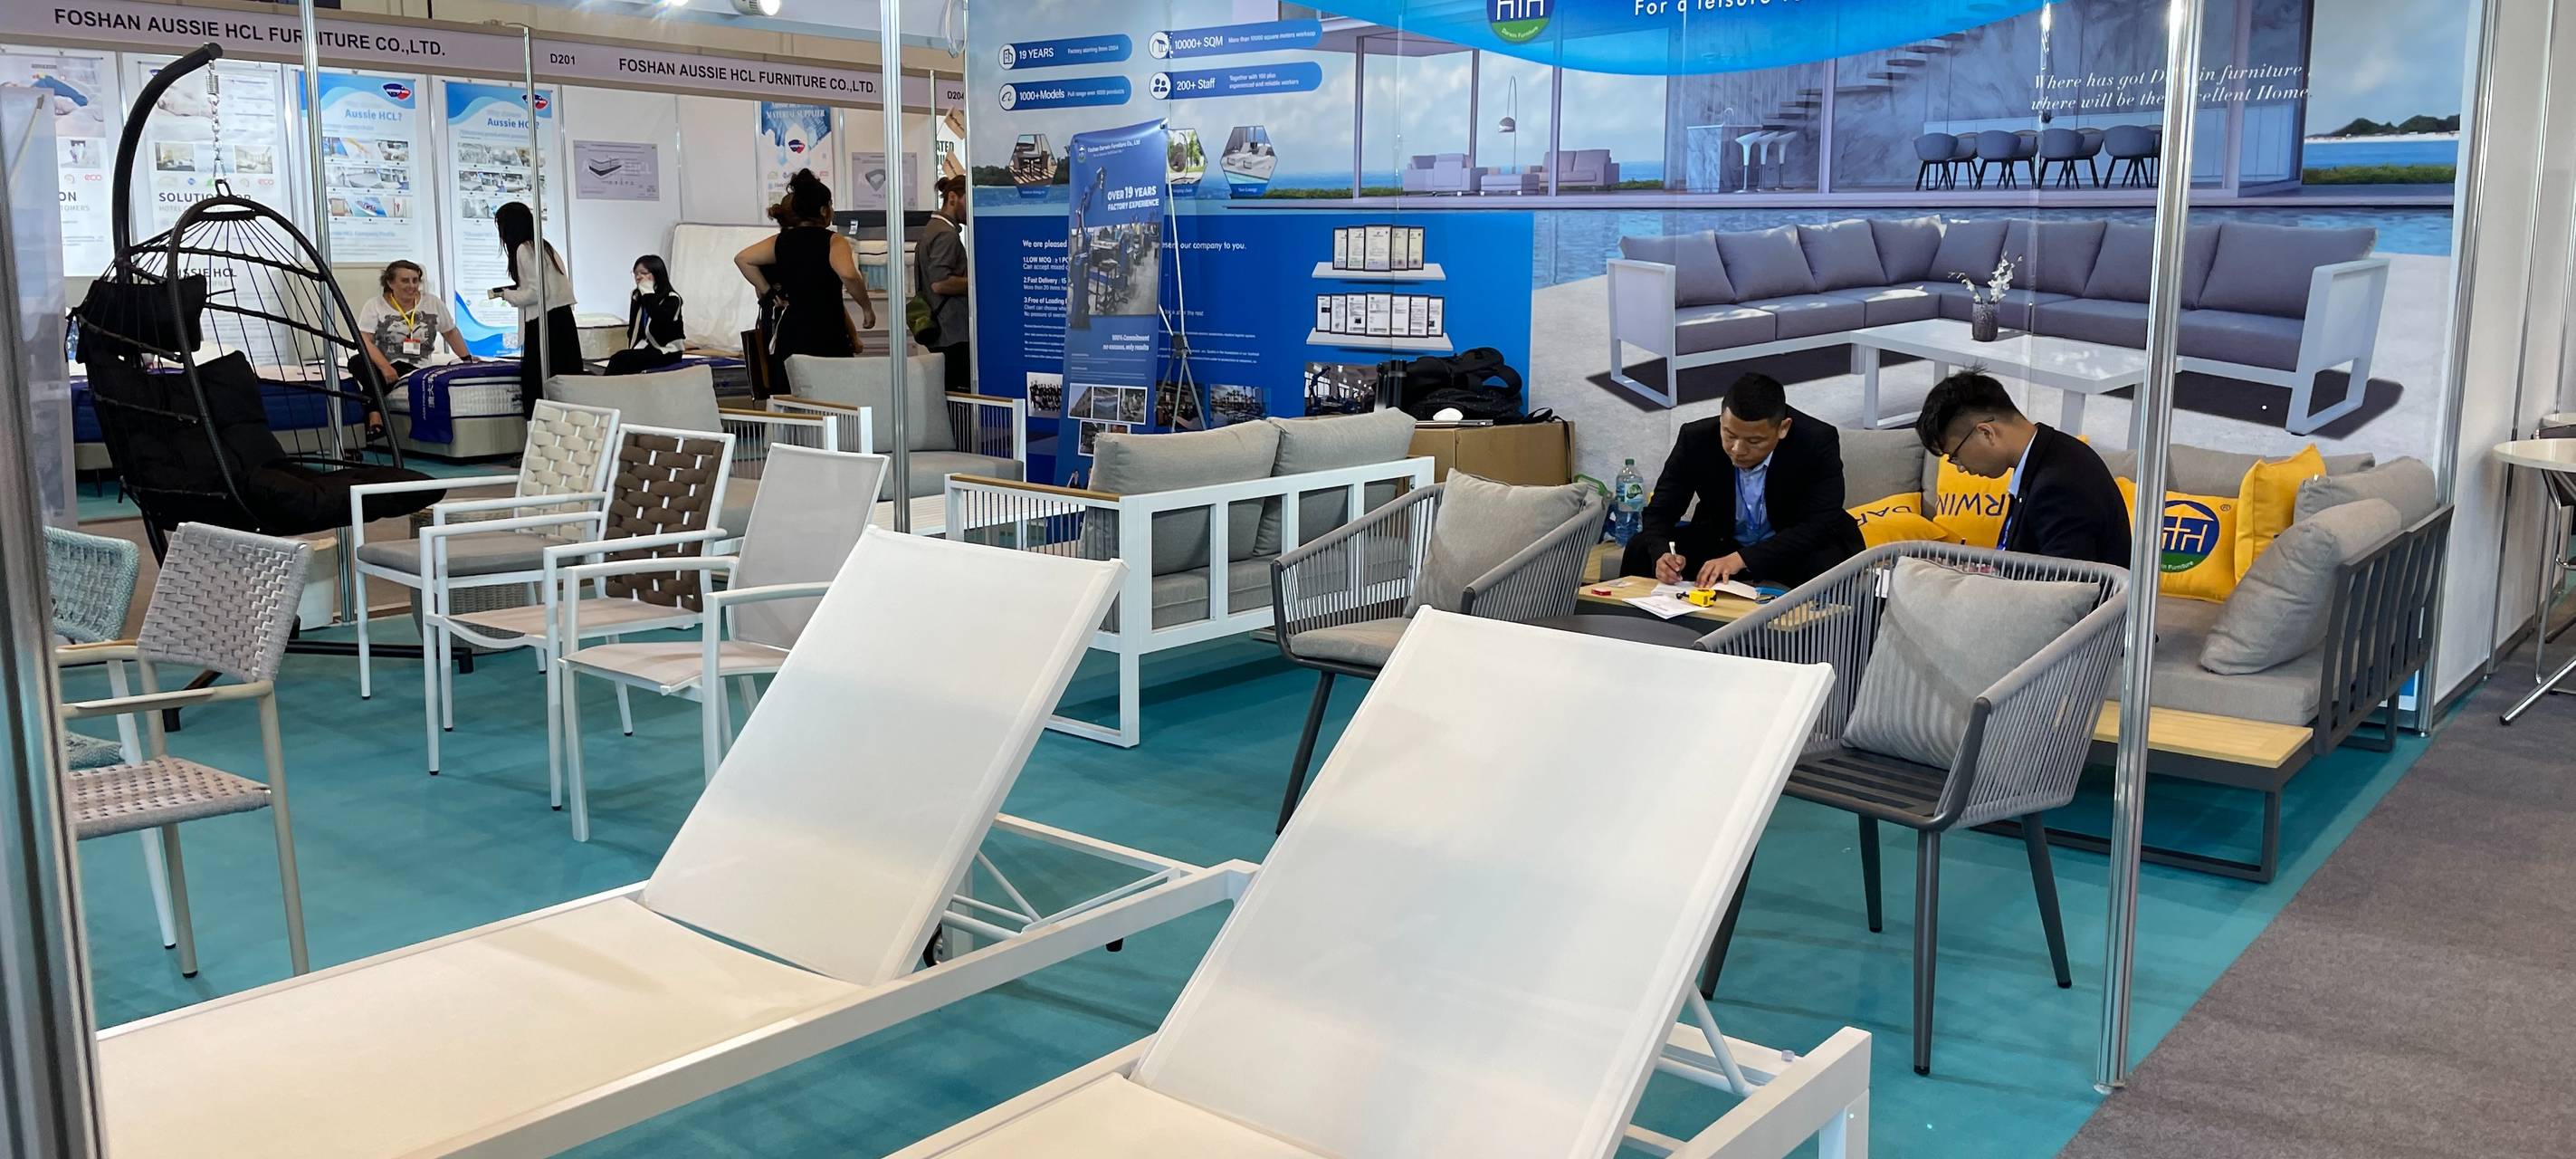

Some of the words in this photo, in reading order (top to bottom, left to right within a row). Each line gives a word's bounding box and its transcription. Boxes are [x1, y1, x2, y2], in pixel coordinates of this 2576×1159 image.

[1635, 1, 1667, 15] For
[54, 8, 141, 31] FOSHAN
[147, 16, 220, 37] AUSSIE
[225, 24, 263, 41] HCL
[269, 27, 371, 50] FURITURE
[376, 37, 446, 56] CO.,LTD.
[1175, 37, 1202, 51] 10000+
[1204, 35, 1224, 48] SQM
[549, 53, 576, 65] D201
[1018, 50, 1027, 60] 19
[1027, 47, 1054, 59] YEARS
[619, 58, 675, 75] FOSHAN
[679, 64, 727, 80] AUSSIE
[730, 68, 756, 82] HCL
[759, 72, 826, 89] FURNITURE
[830, 78, 877, 93] CO.,LTD.
[2036, 74, 2082, 89] Where
[2086, 72, 2114, 87] has
[2117, 72, 2145, 91] got
[1177, 80, 1196, 91] 200+
[1197, 78, 1216, 90] Staff
[1019, 89, 1065, 101] 1000+Models
[2031, 95, 2076, 110] where
[2081, 91, 2113, 109] will
[2117, 91, 2135, 106] be
[2140, 91, 2165, 106] the
[345, 108, 377, 120] Aussie
[378, 111, 403, 122] HCL?
[487, 118, 517, 129] Aussie
[1107, 189, 1124, 201] OVER
[1124, 186, 1133, 198] 19
[1134, 186, 1157, 197] YEARS
[1107, 202, 1129, 211] FACTORY
[1128, 198, 1159, 209] EXPERIENCE
[1022, 239, 1032, 248] We
[1044, 239, 1068, 250] pleased
[1192, 242, 1223, 252] company
[1224, 241, 1231, 249] to
[1935, 492, 2007, 517] RWIN
